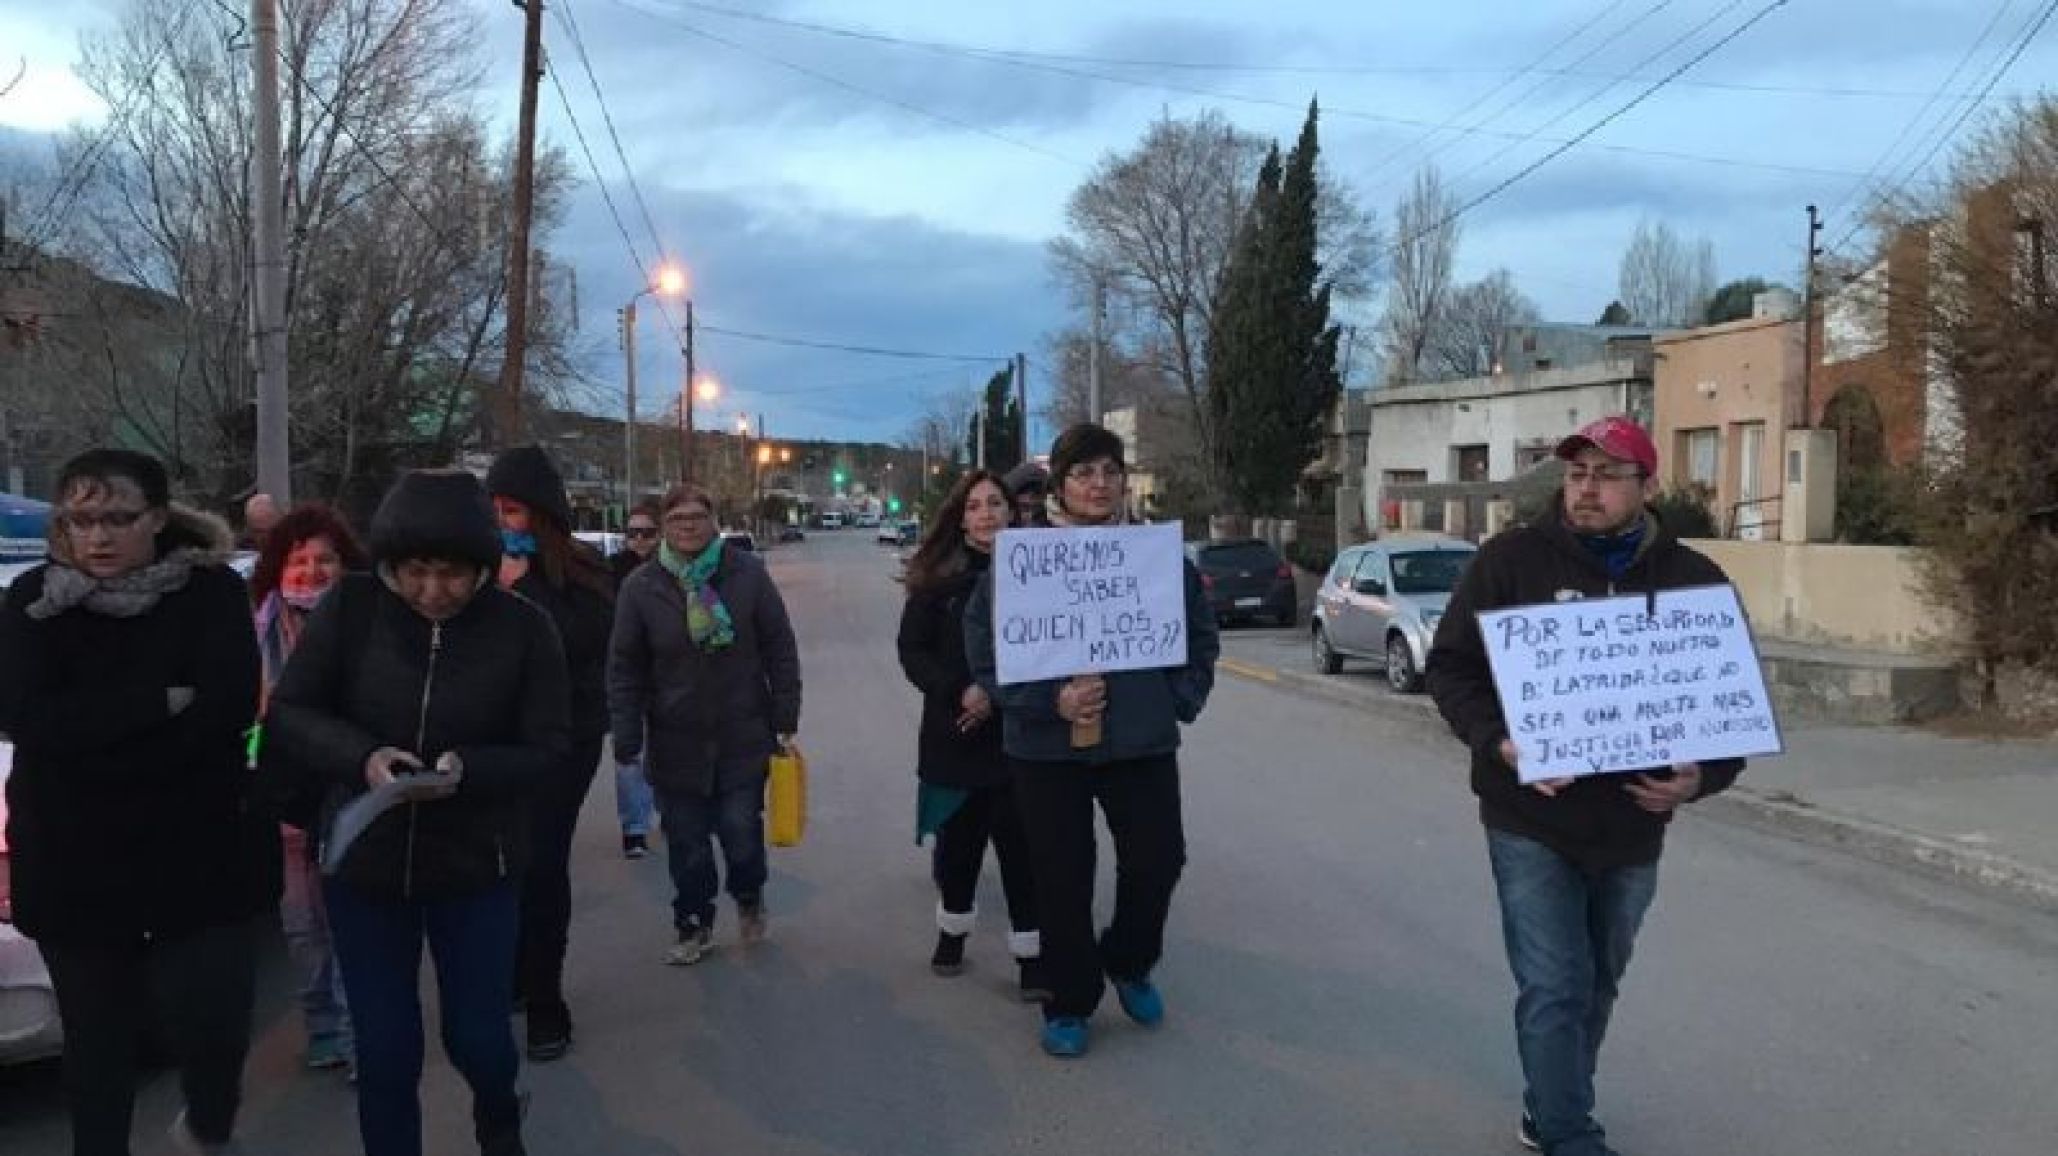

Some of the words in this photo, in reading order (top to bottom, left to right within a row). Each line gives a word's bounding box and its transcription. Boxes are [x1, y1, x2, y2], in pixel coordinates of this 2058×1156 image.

[1009, 540, 1125, 585] QUEREMOS
[1064, 575, 1141, 605] SABER
[1003, 614, 1084, 645] QUIEN
[1100, 609, 1151, 635] LOS
[1497, 614, 1561, 651] POR
[1577, 615, 1608, 640] LA
